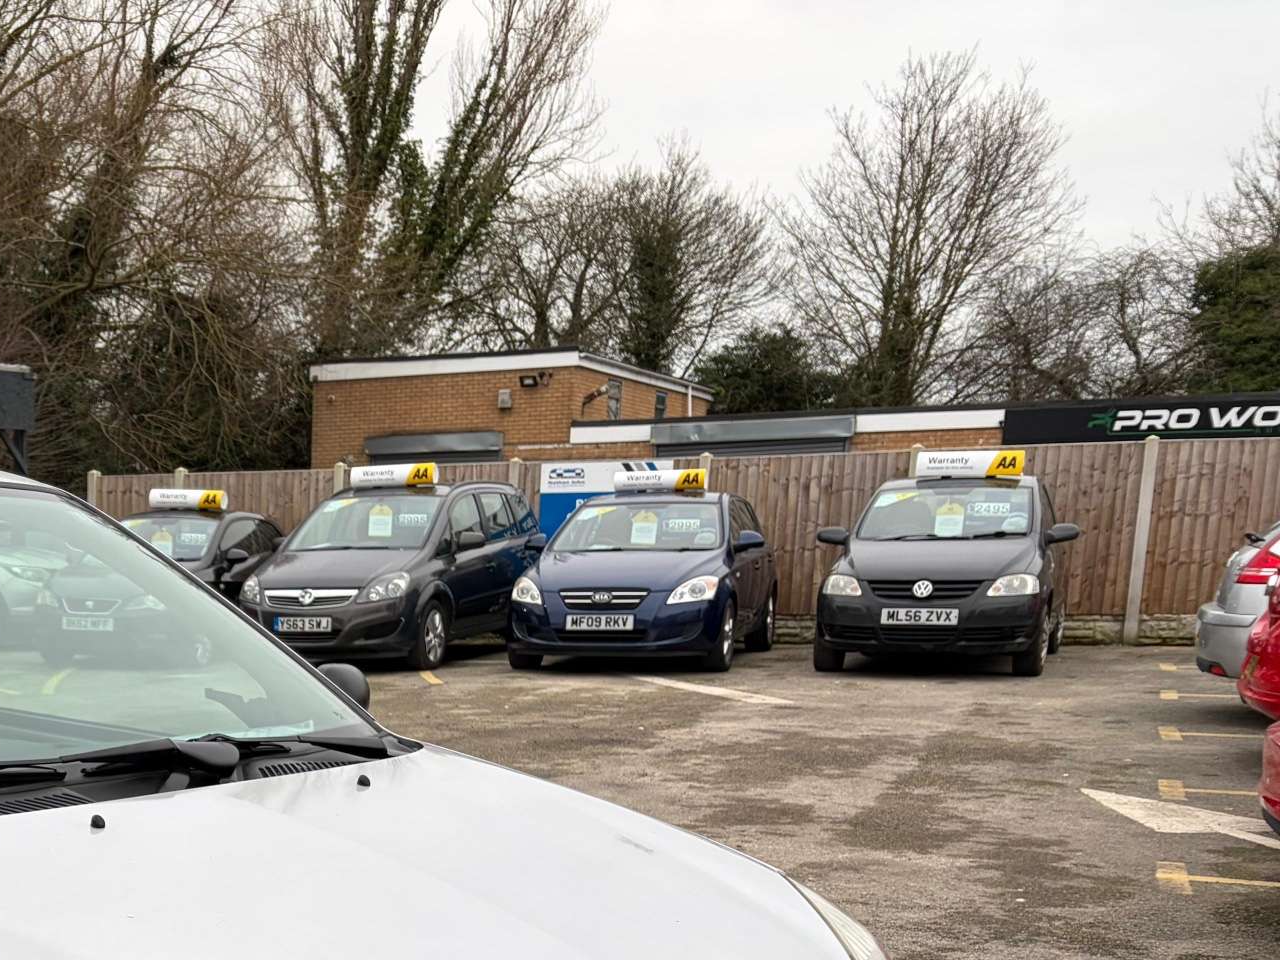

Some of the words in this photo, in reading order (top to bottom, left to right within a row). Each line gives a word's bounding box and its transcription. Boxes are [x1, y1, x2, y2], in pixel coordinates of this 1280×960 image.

[1112, 407, 1201, 432] PRO
[1209, 405, 1280, 428] WO
[928, 456, 970, 465] Warranty
[996, 456, 1017, 469] AA
[413, 468, 429, 480] AA
[627, 473, 663, 482] Warranty
[682, 472, 699, 485] AA
[203, 493, 217, 505] AA
[571, 616, 602, 628] MF09
[605, 616, 629, 628] RKV
[886, 610, 922, 622] ML56
[926, 610, 952, 622] ZVX
[280, 618, 305, 630] YS63
[308, 618, 329, 630] SWJ
